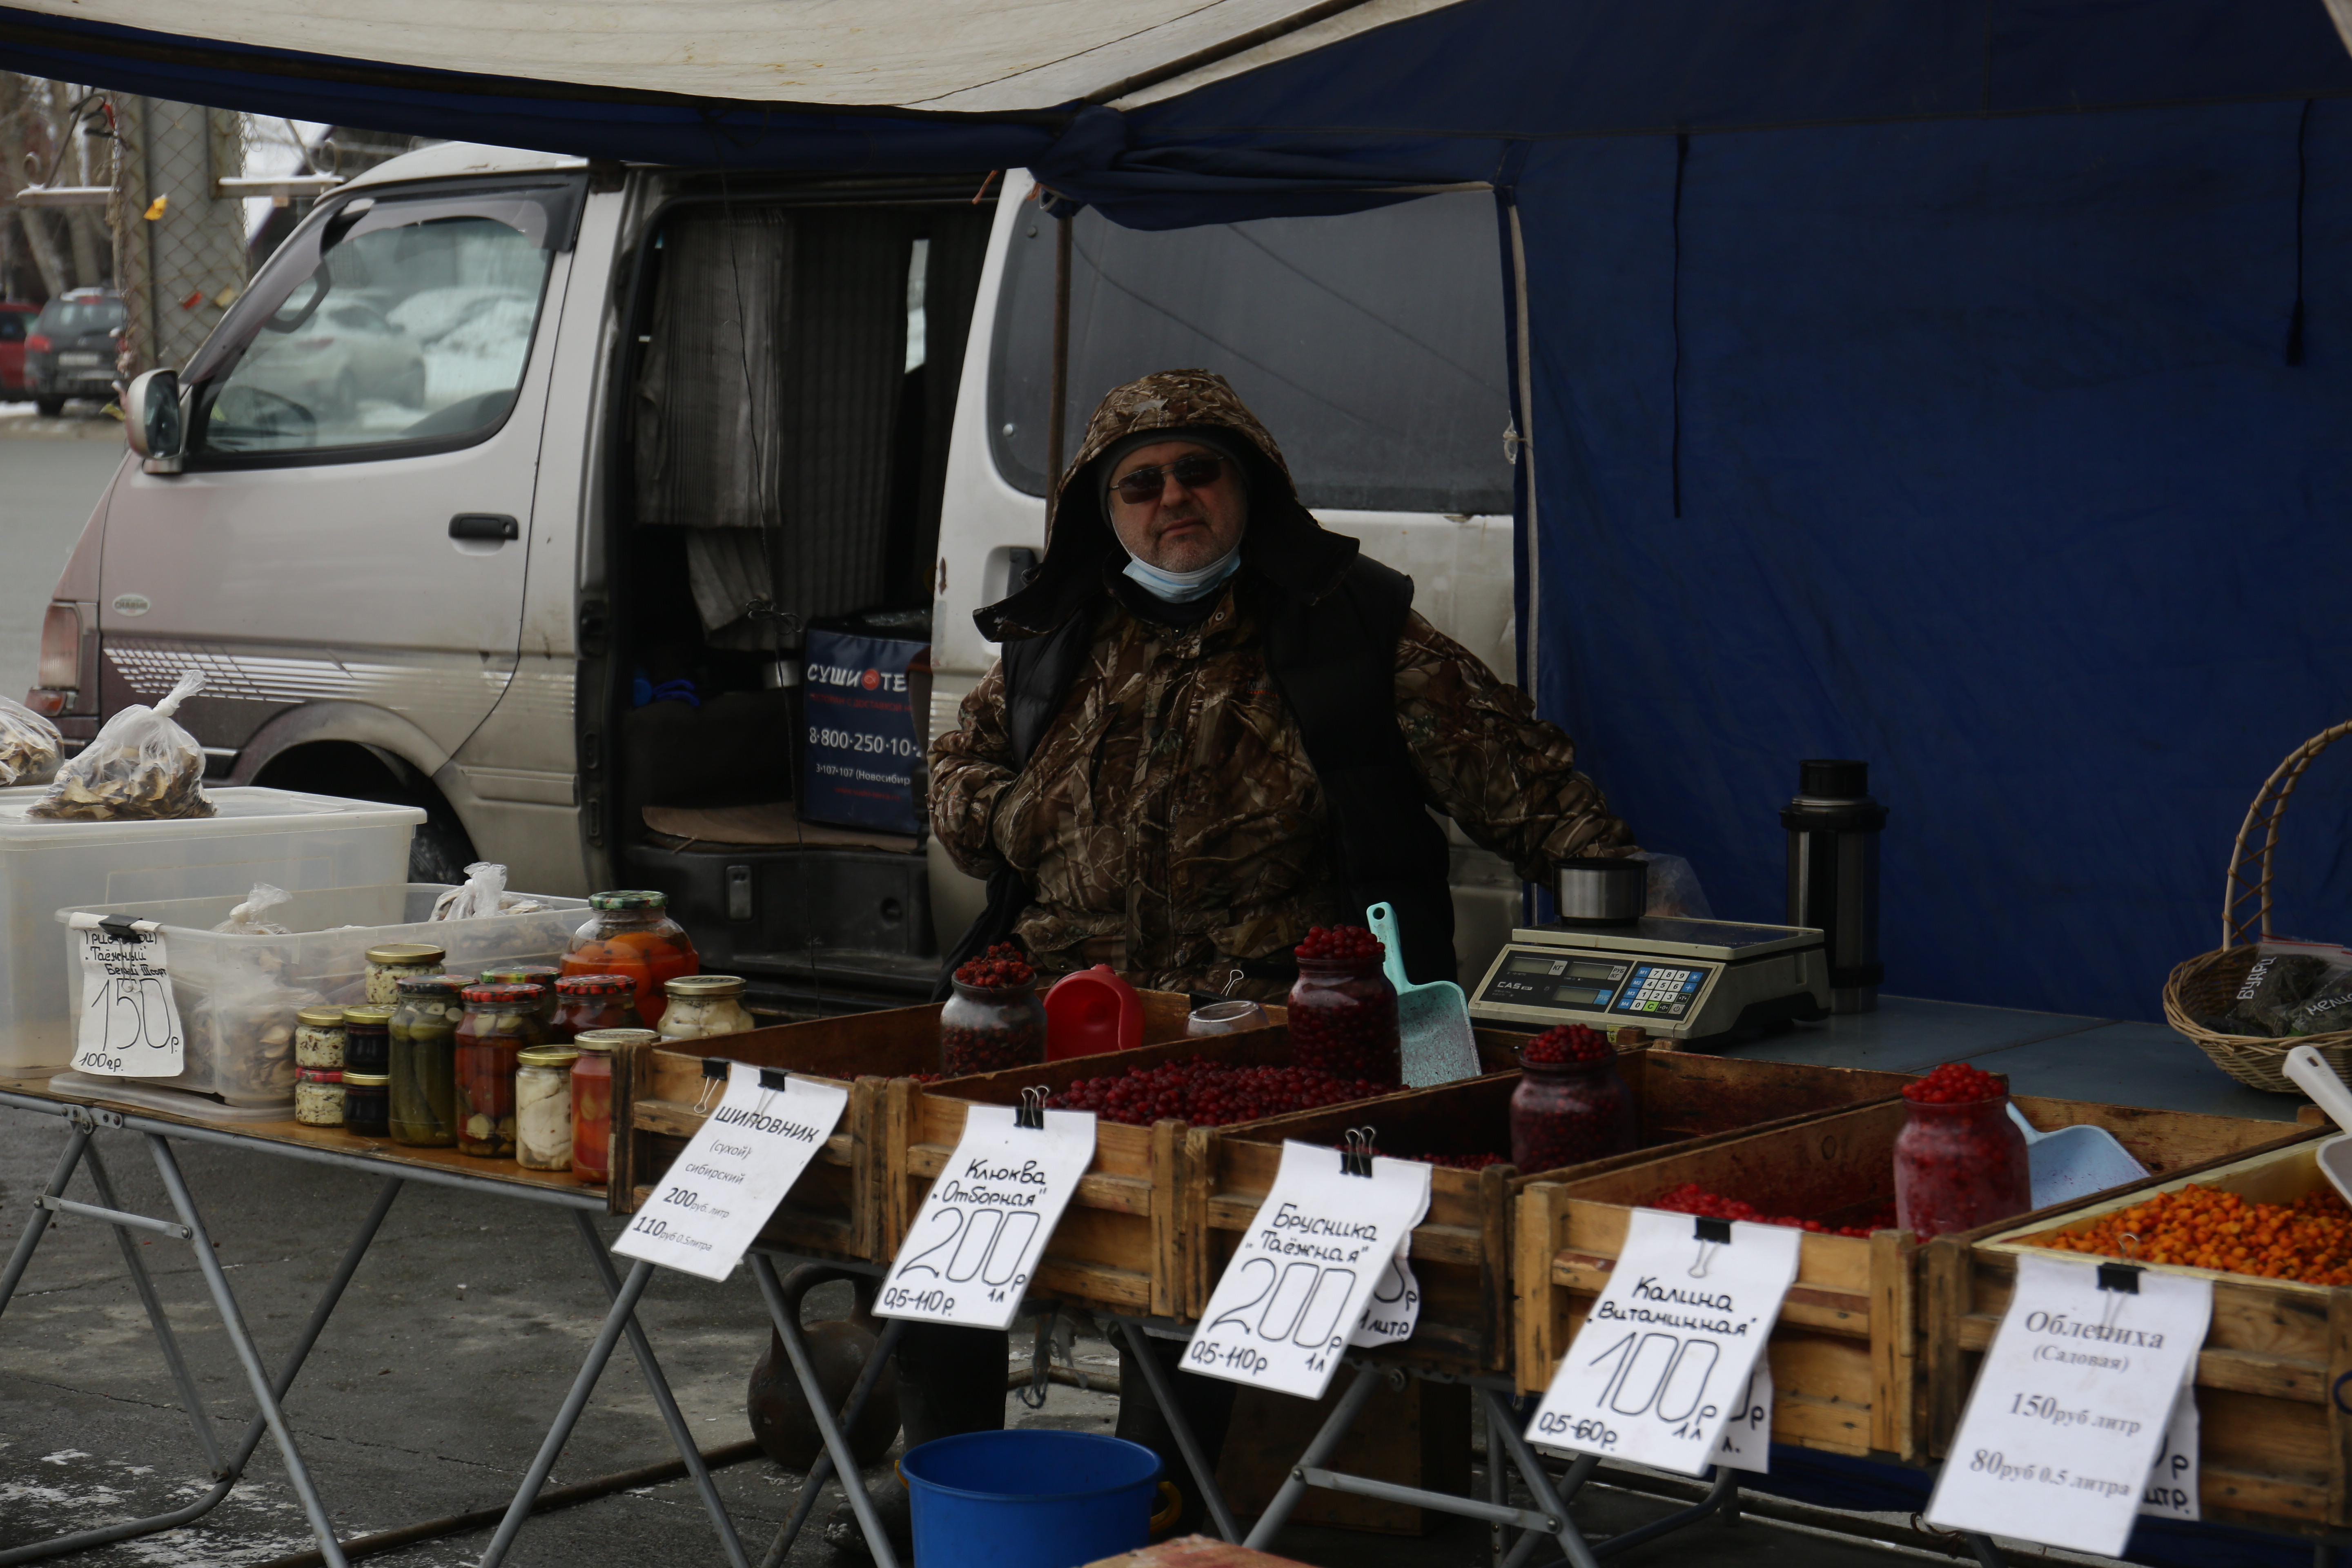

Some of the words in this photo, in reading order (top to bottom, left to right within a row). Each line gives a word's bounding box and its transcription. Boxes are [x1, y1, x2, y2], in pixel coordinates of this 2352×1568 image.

[807, 664, 862, 688] СУШИ
[881, 673, 909, 693] ТЕ
[856, 770, 911, 786] (Новосибир
[714, 1105, 820, 1144] ШИПОВНИК
[685, 1162, 746, 1185] сибирский
[964, 1158, 1047, 1185] Клюква
[1272, 1203, 1377, 1242] Брусника
[1632, 1276, 1734, 1312] Калина
[2025, 1311, 2165, 1350] Облепиха
[2033, 1345, 2130, 1373] (Садовая)
[2091, 1415, 2142, 1437] литр
[2069, 1474, 2131, 1499] литра
